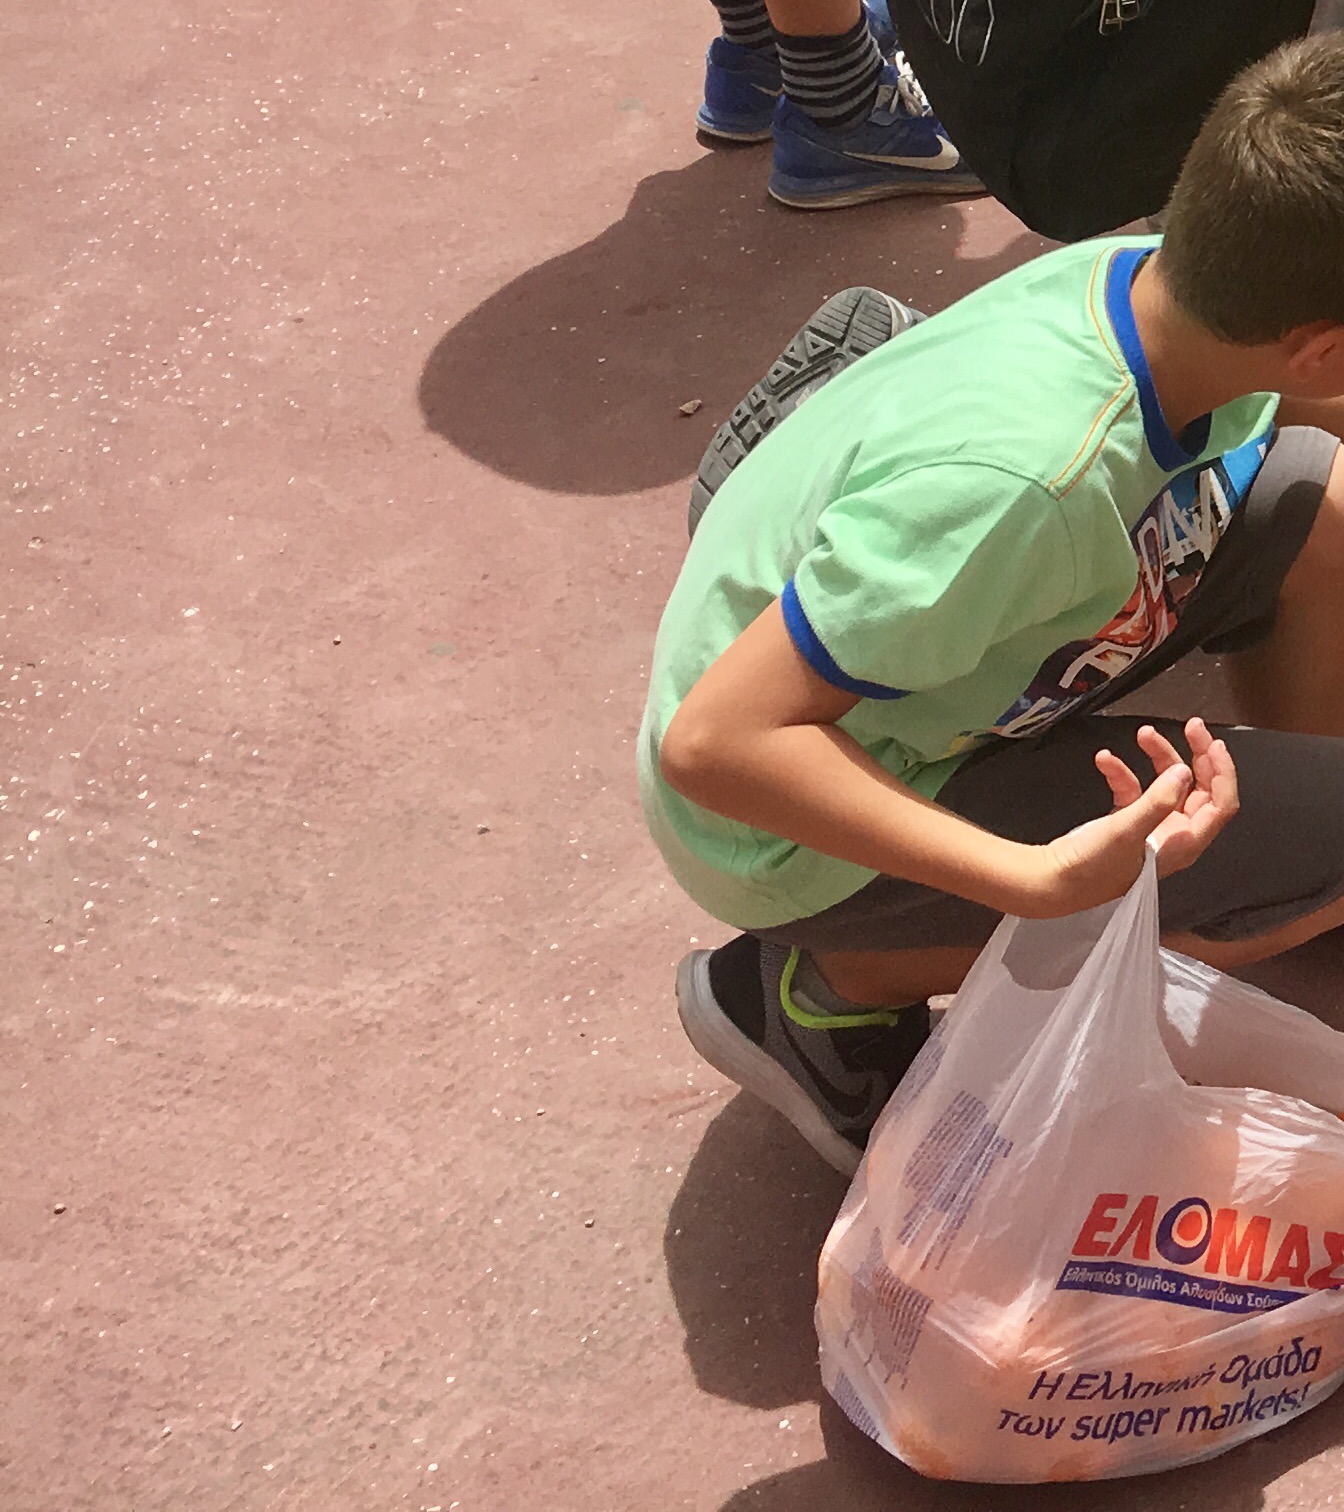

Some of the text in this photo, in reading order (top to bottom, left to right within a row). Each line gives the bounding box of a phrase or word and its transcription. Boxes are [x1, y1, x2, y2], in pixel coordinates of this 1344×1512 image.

[998, 1381, 1310, 1445] των super markets!
